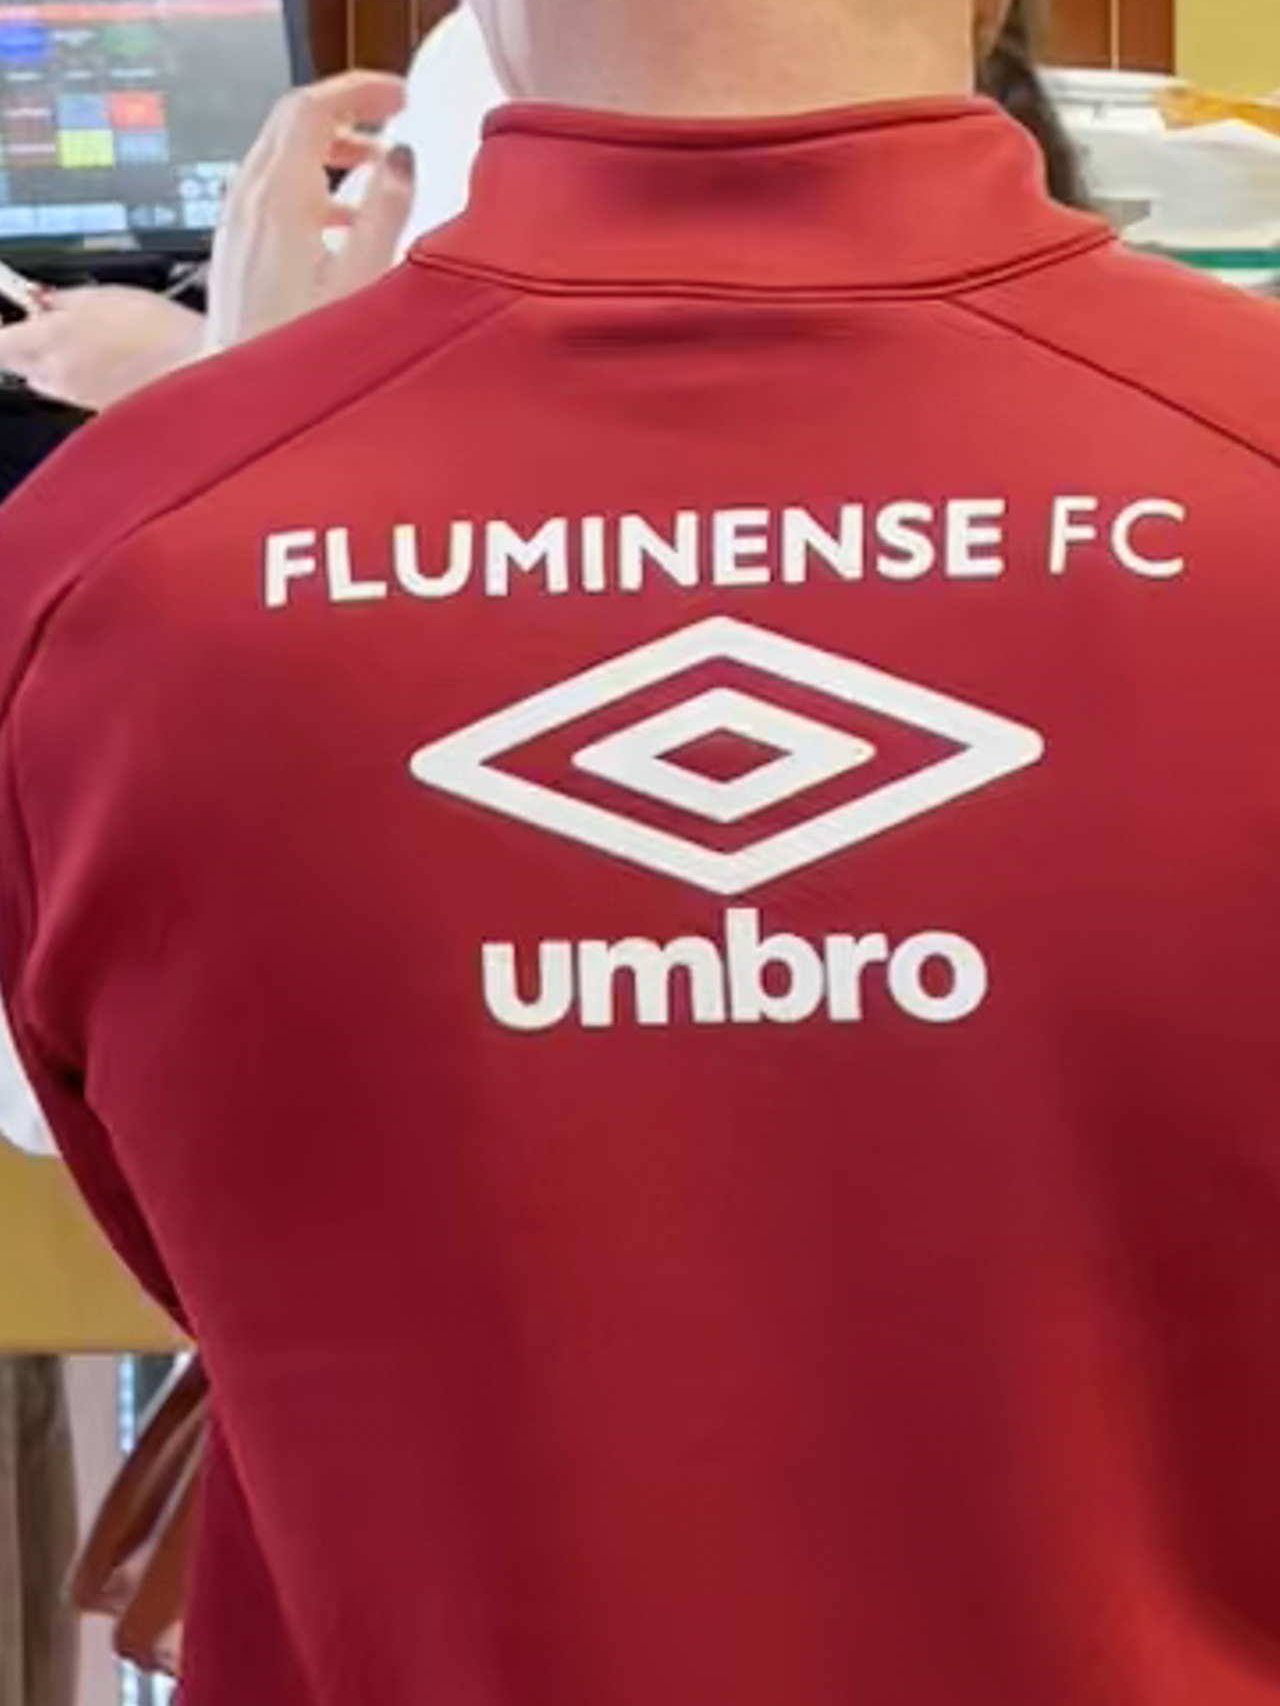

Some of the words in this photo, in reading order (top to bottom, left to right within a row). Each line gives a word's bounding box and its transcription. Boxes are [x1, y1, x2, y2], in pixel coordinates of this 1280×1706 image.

[266, 499, 1004, 607] FLUMINENSE
[1049, 495, 1185, 578] FC
[483, 908, 986, 1029] umbro
